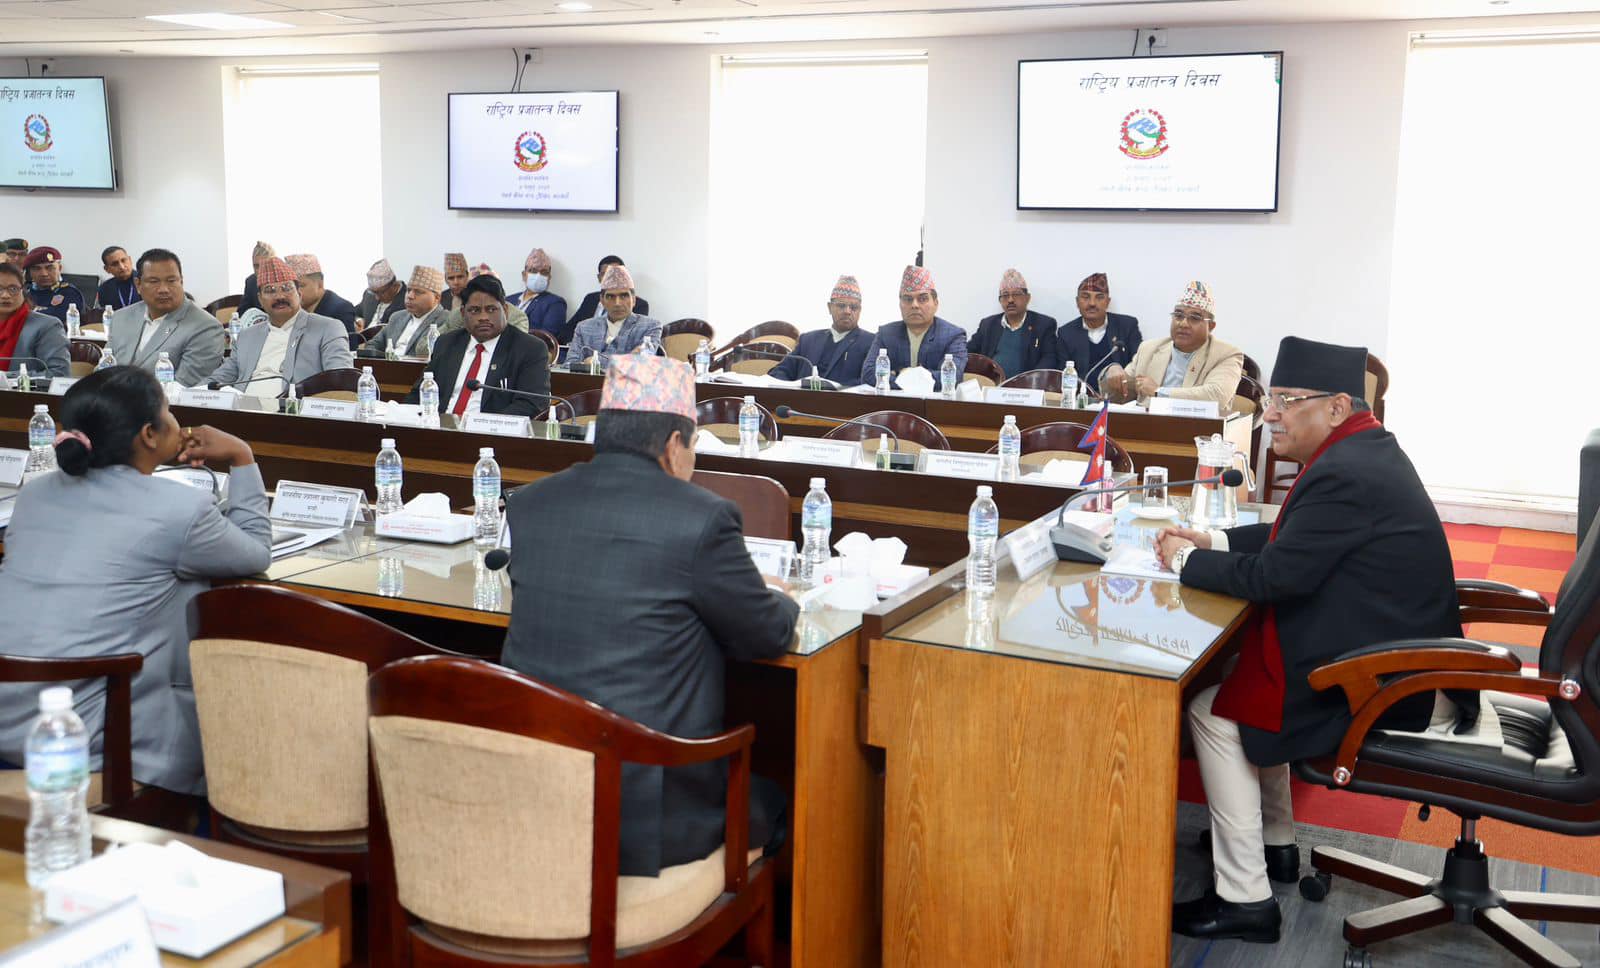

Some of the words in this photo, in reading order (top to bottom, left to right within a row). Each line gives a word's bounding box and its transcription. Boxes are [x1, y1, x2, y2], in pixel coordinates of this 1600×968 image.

[1079, 72, 1119, 94] राष्ट्रिय
[1127, 74, 1179, 89] प्रजातन्त्र
[1184, 69, 1222, 88] दिवस
[0, 86, 20, 102] ाष्ट्रिय
[55, 86, 76, 99] दिवस
[486, 101, 514, 118] राष्ट्रिय
[518, 103, 553, 116] प्रजातन्त्र
[557, 101, 583, 115] दिवस
